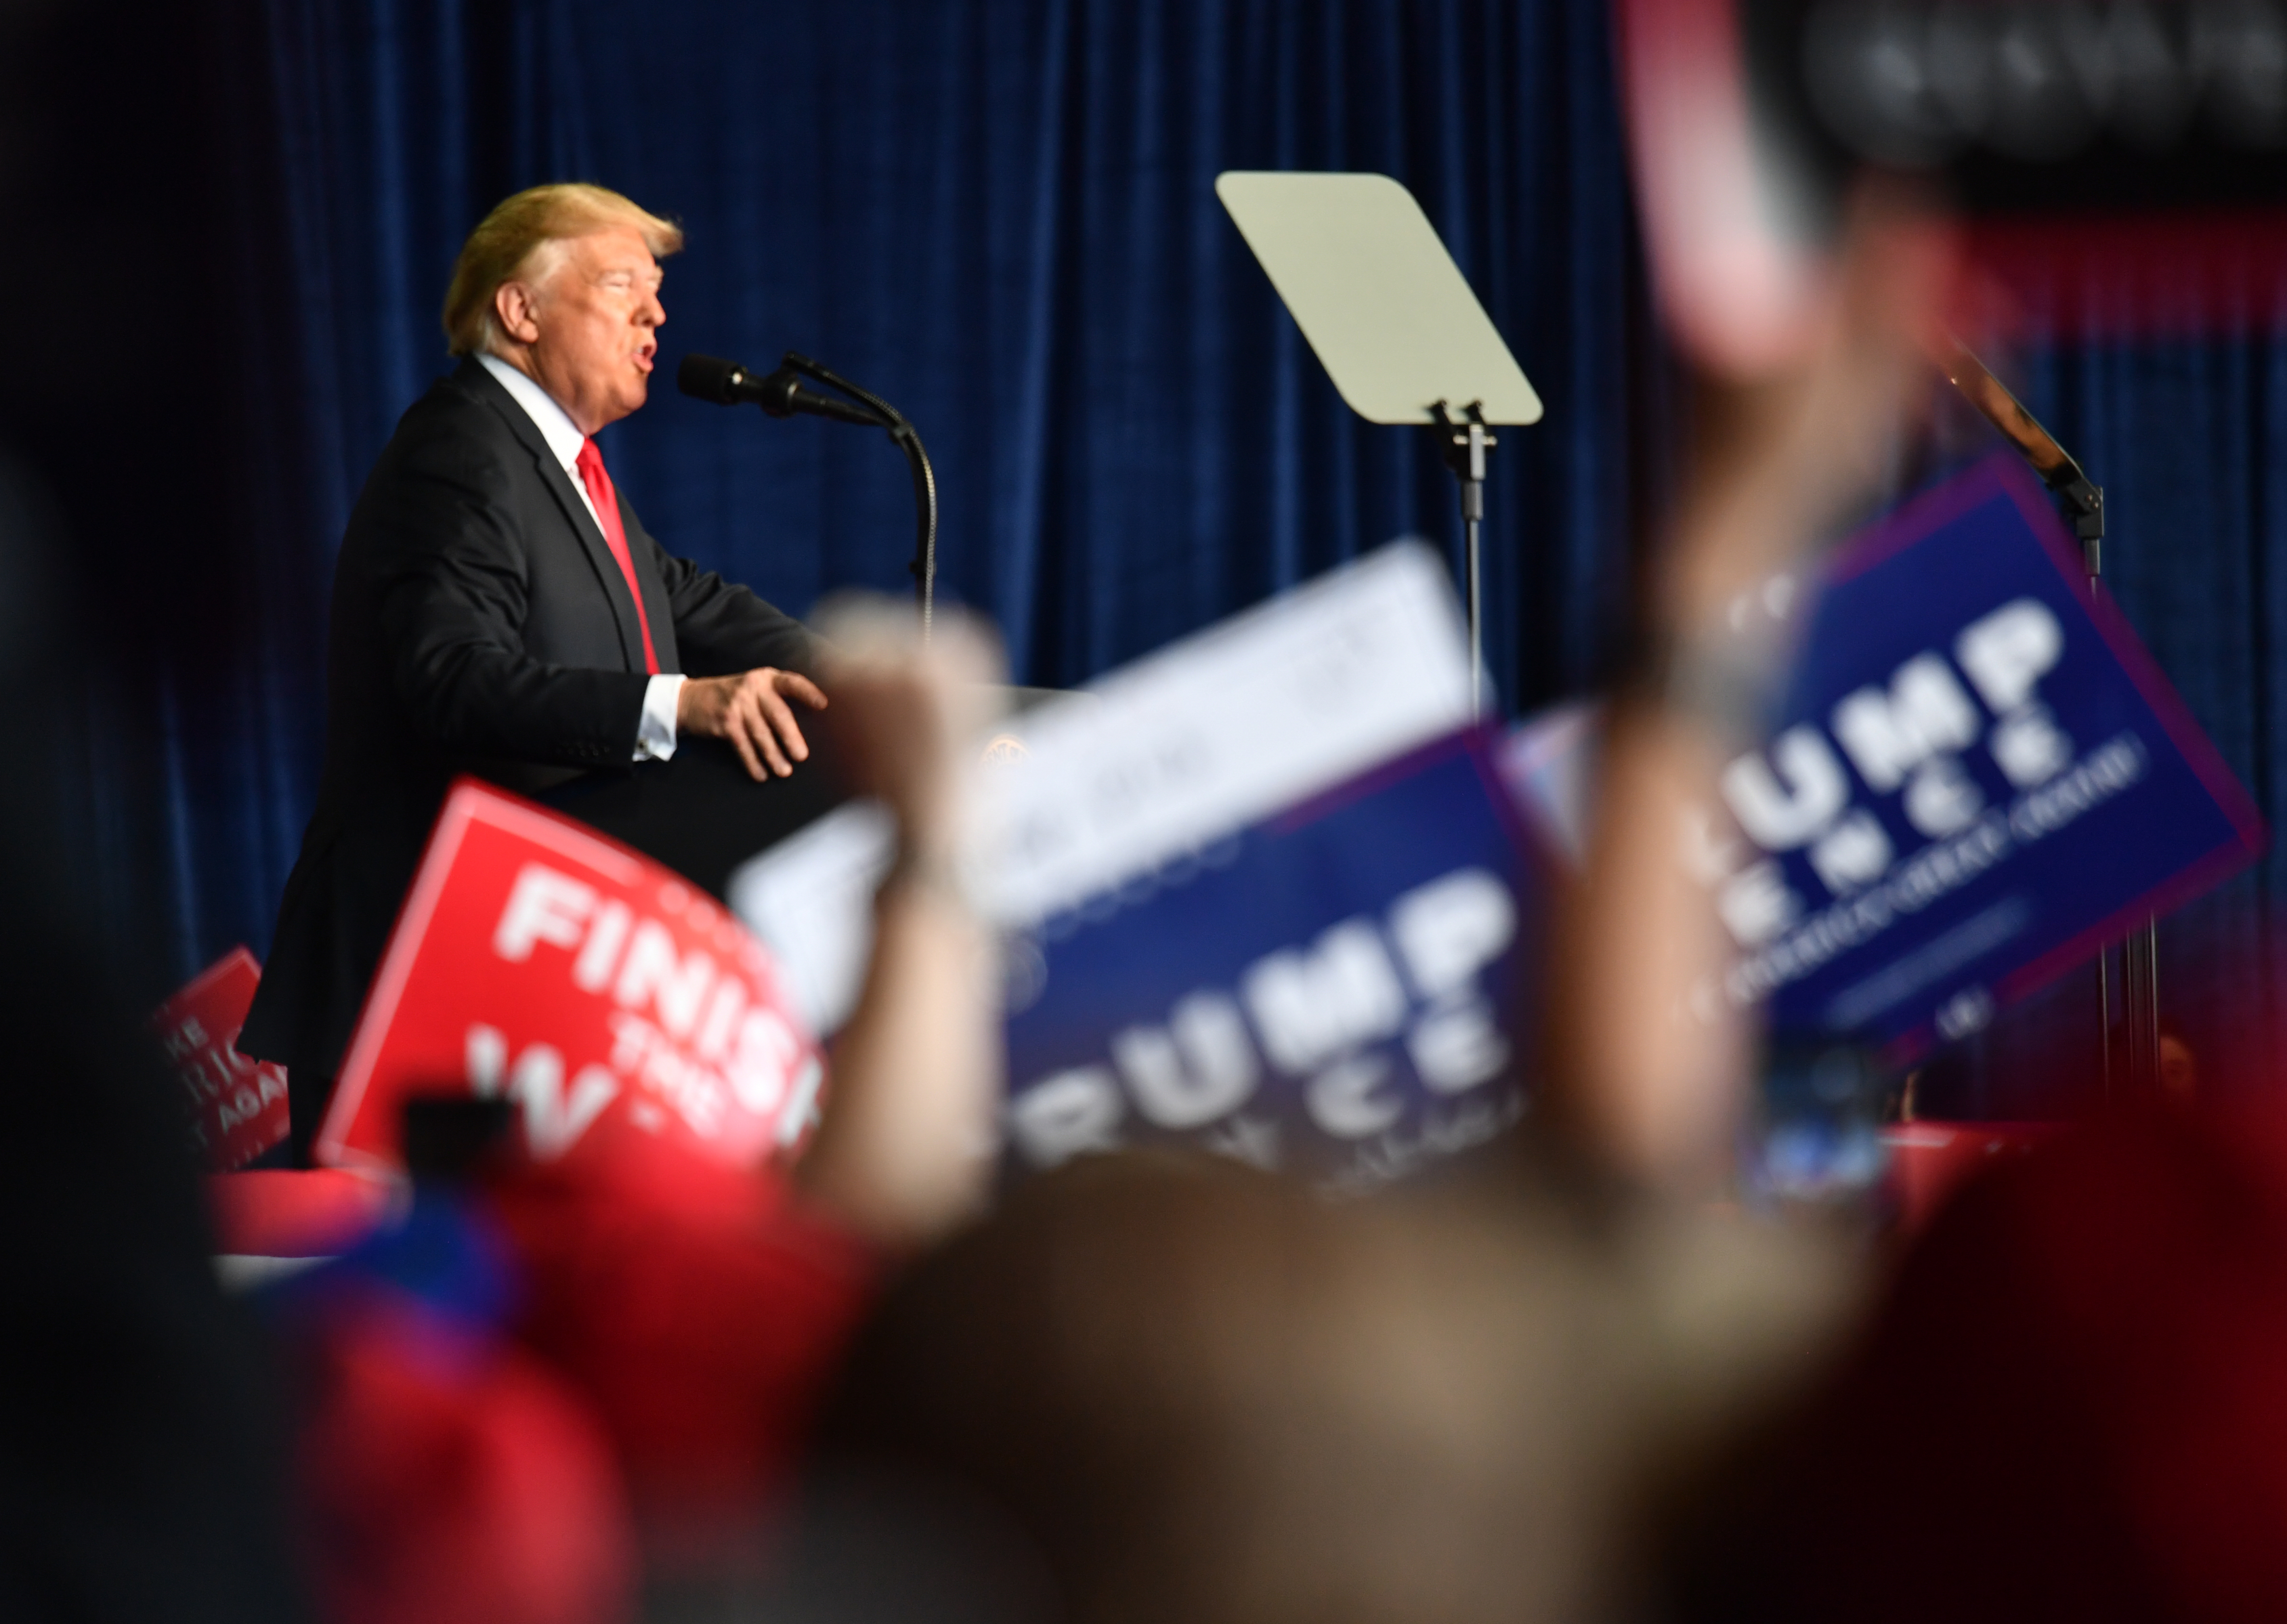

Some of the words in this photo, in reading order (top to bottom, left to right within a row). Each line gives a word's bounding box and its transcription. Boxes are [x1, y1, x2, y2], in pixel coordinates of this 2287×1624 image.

[1716, 597, 2065, 855] UMP
[1716, 701, 2075, 948] ENCE
[165, 1016, 209, 1063] KE
[1009, 865, 1518, 1173] RUMP
